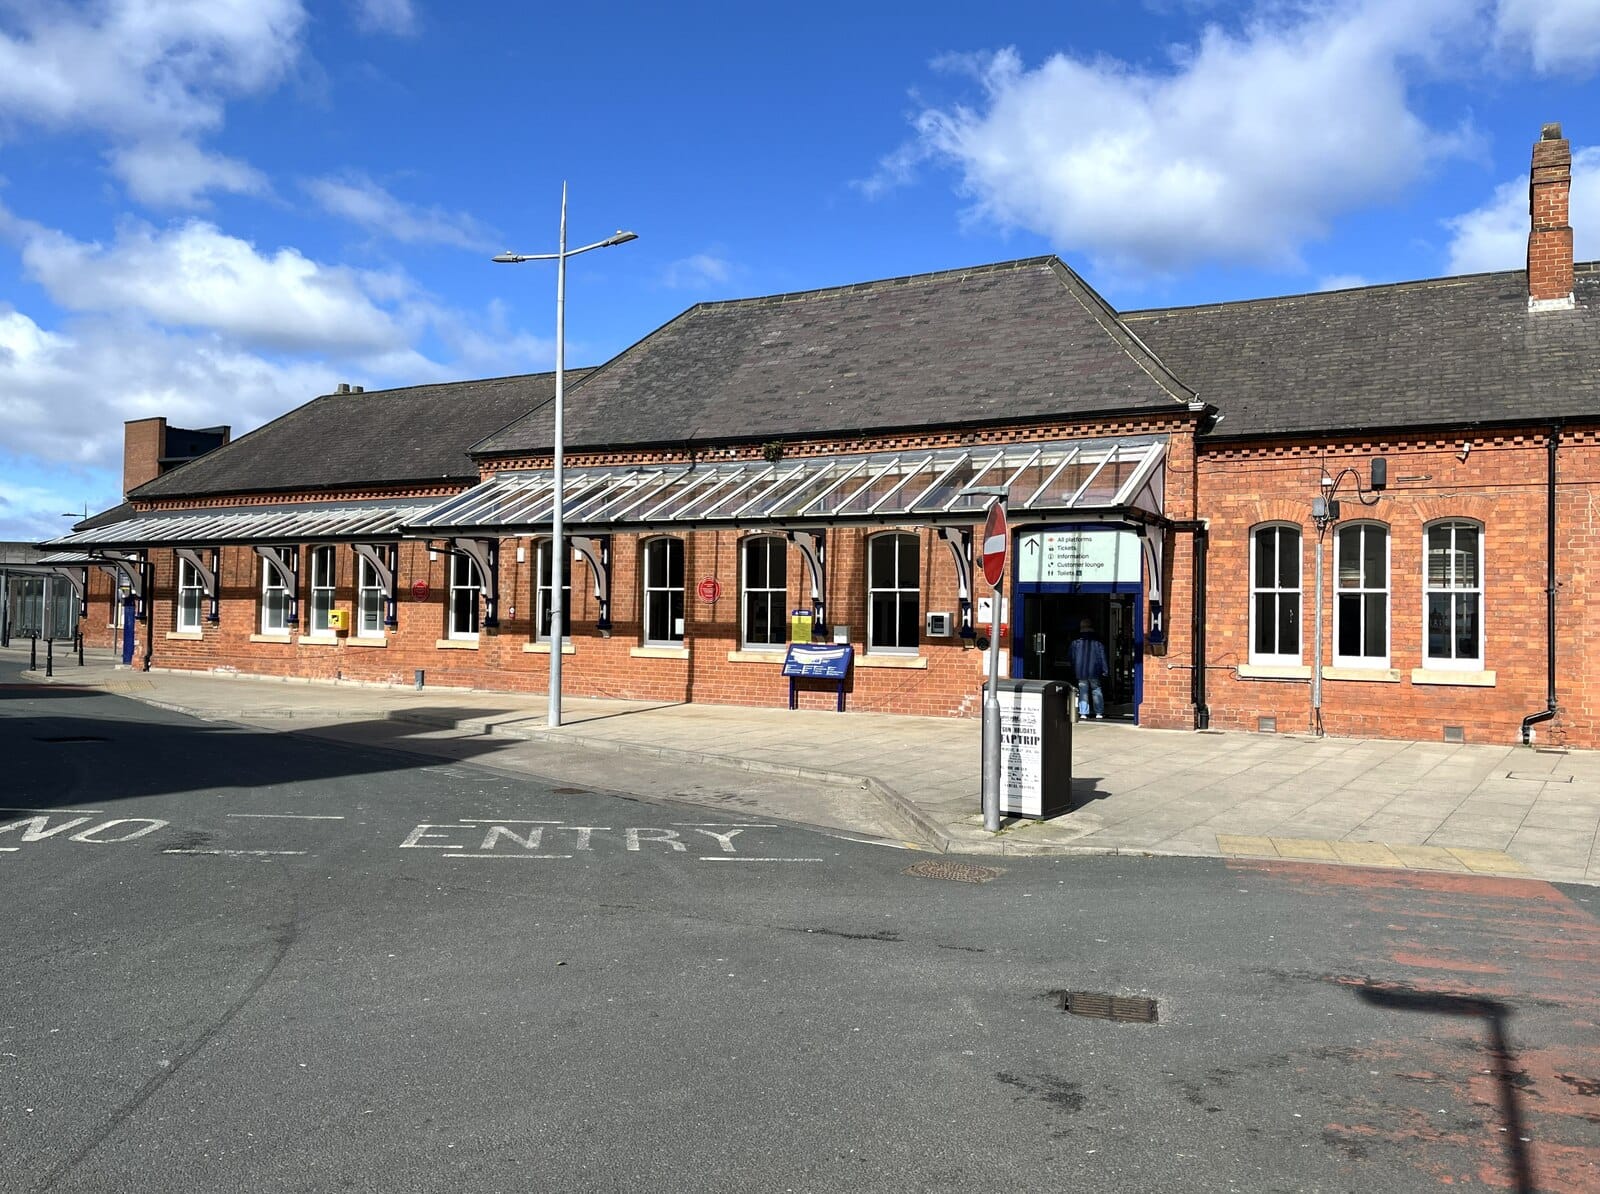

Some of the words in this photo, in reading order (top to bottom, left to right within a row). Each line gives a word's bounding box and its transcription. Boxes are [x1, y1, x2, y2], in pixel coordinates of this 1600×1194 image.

[1000, 734, 1017, 745] EAP
[1017, 734, 1040, 746] TRIP
[0, 816, 170, 843] NO
[399, 824, 745, 852] ENTRY
